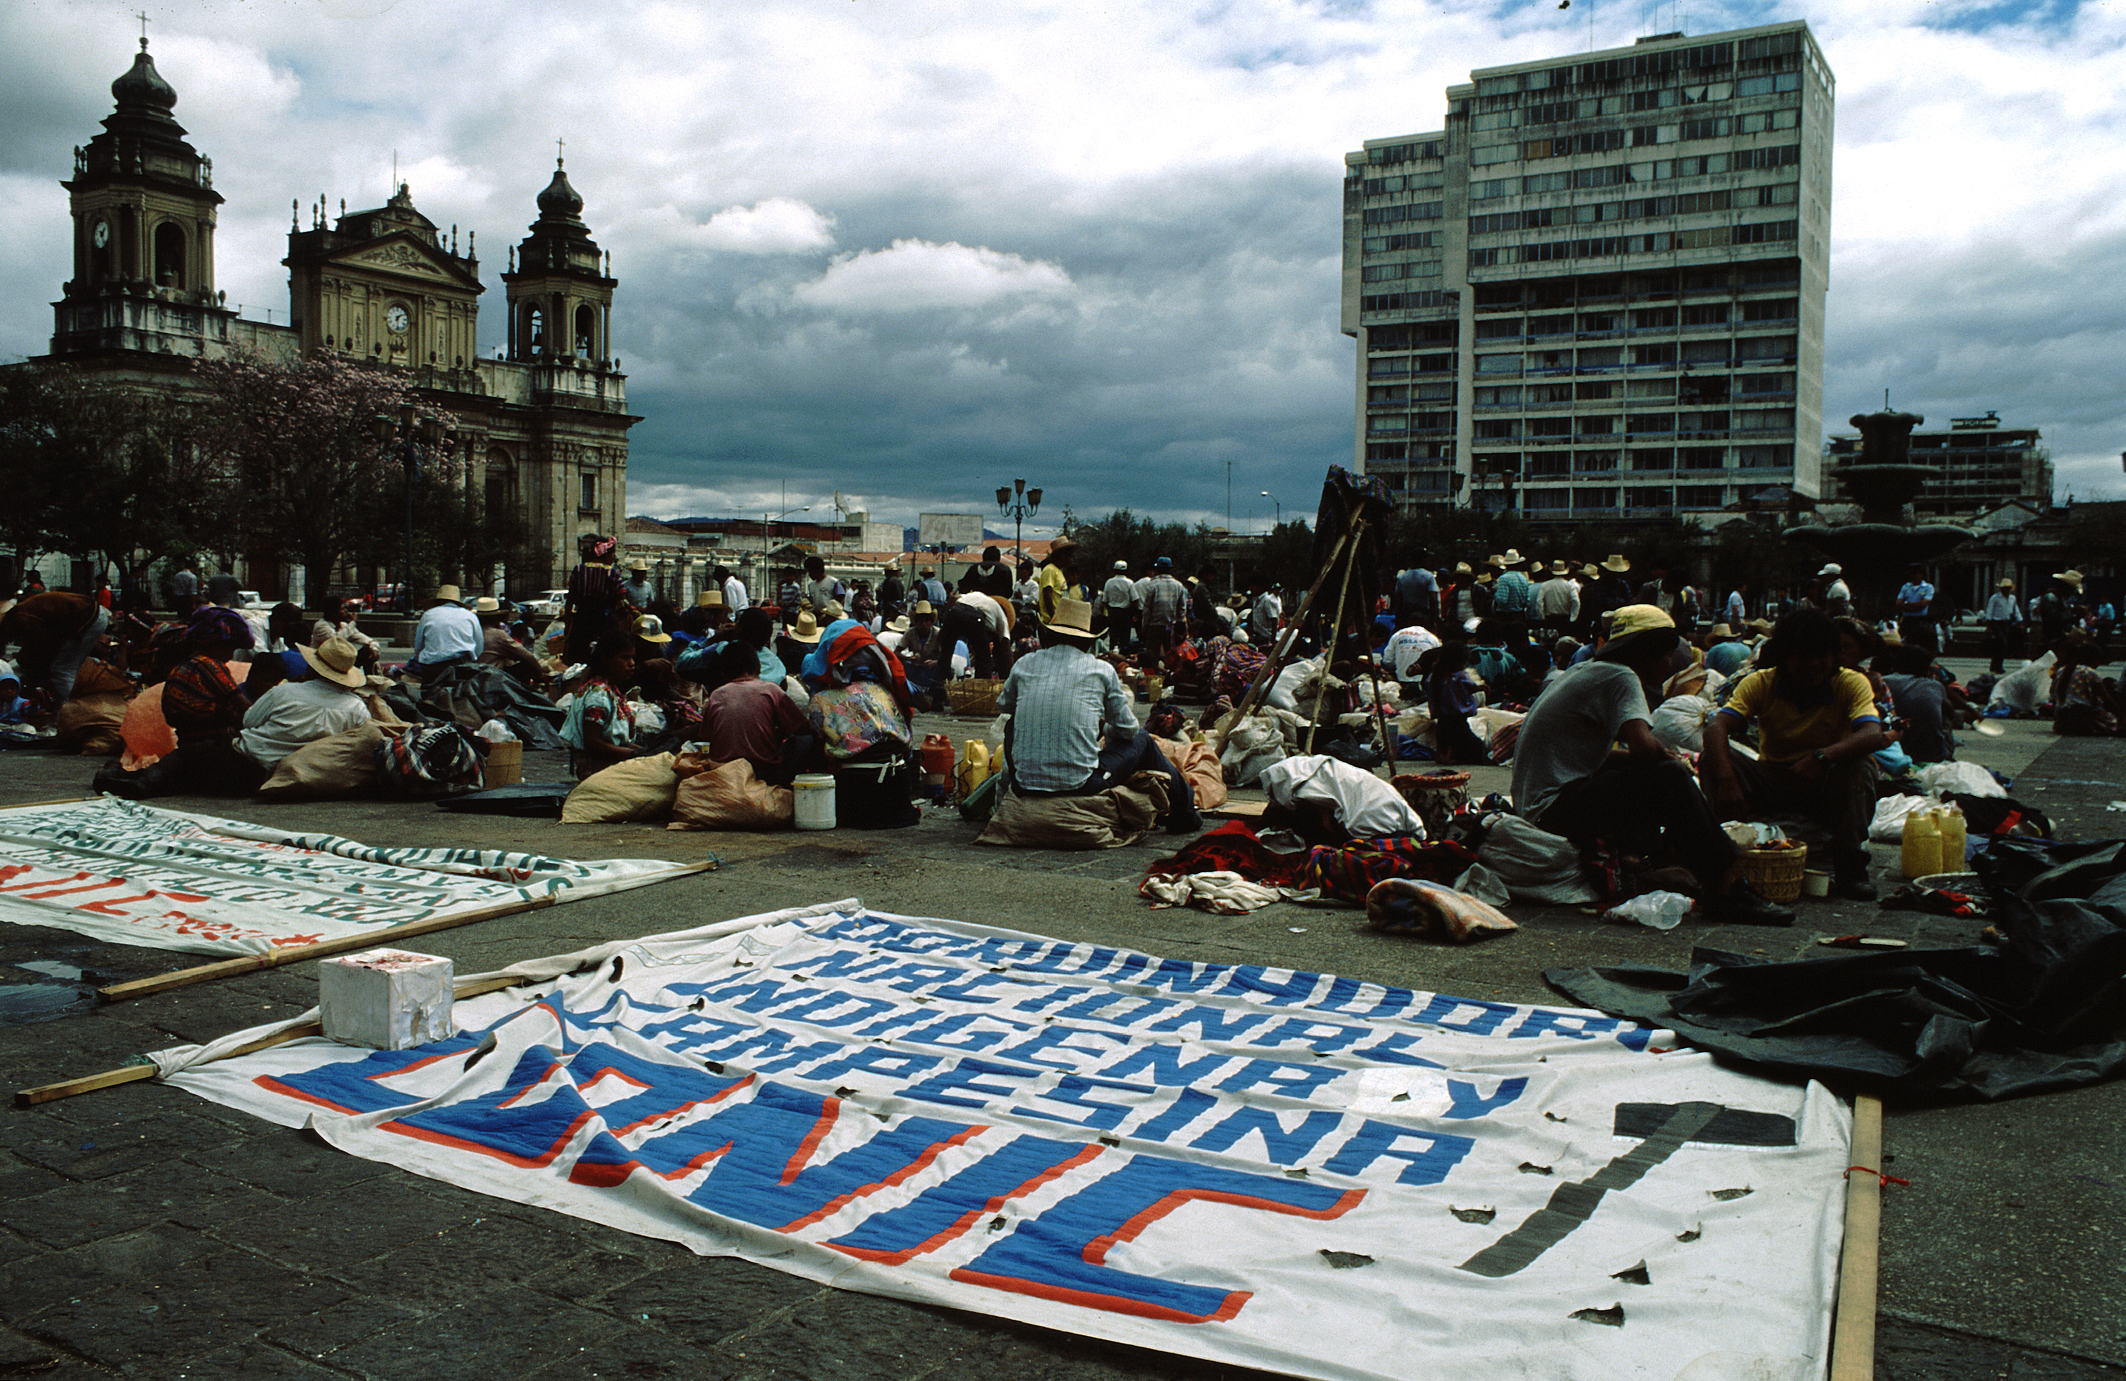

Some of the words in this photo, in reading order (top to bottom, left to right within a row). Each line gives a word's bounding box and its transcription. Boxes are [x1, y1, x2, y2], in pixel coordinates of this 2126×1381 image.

[662, 968, 1349, 1099] INDIGENA
[1440, 1076, 1529, 1120] Y
[773, 950, 1448, 1068] NACIONAL
[790, 911, 1652, 1052] OORDINADOR
[253, 990, 1369, 1323] CONIC
[563, 988, 1477, 1187] CAMPESINA
